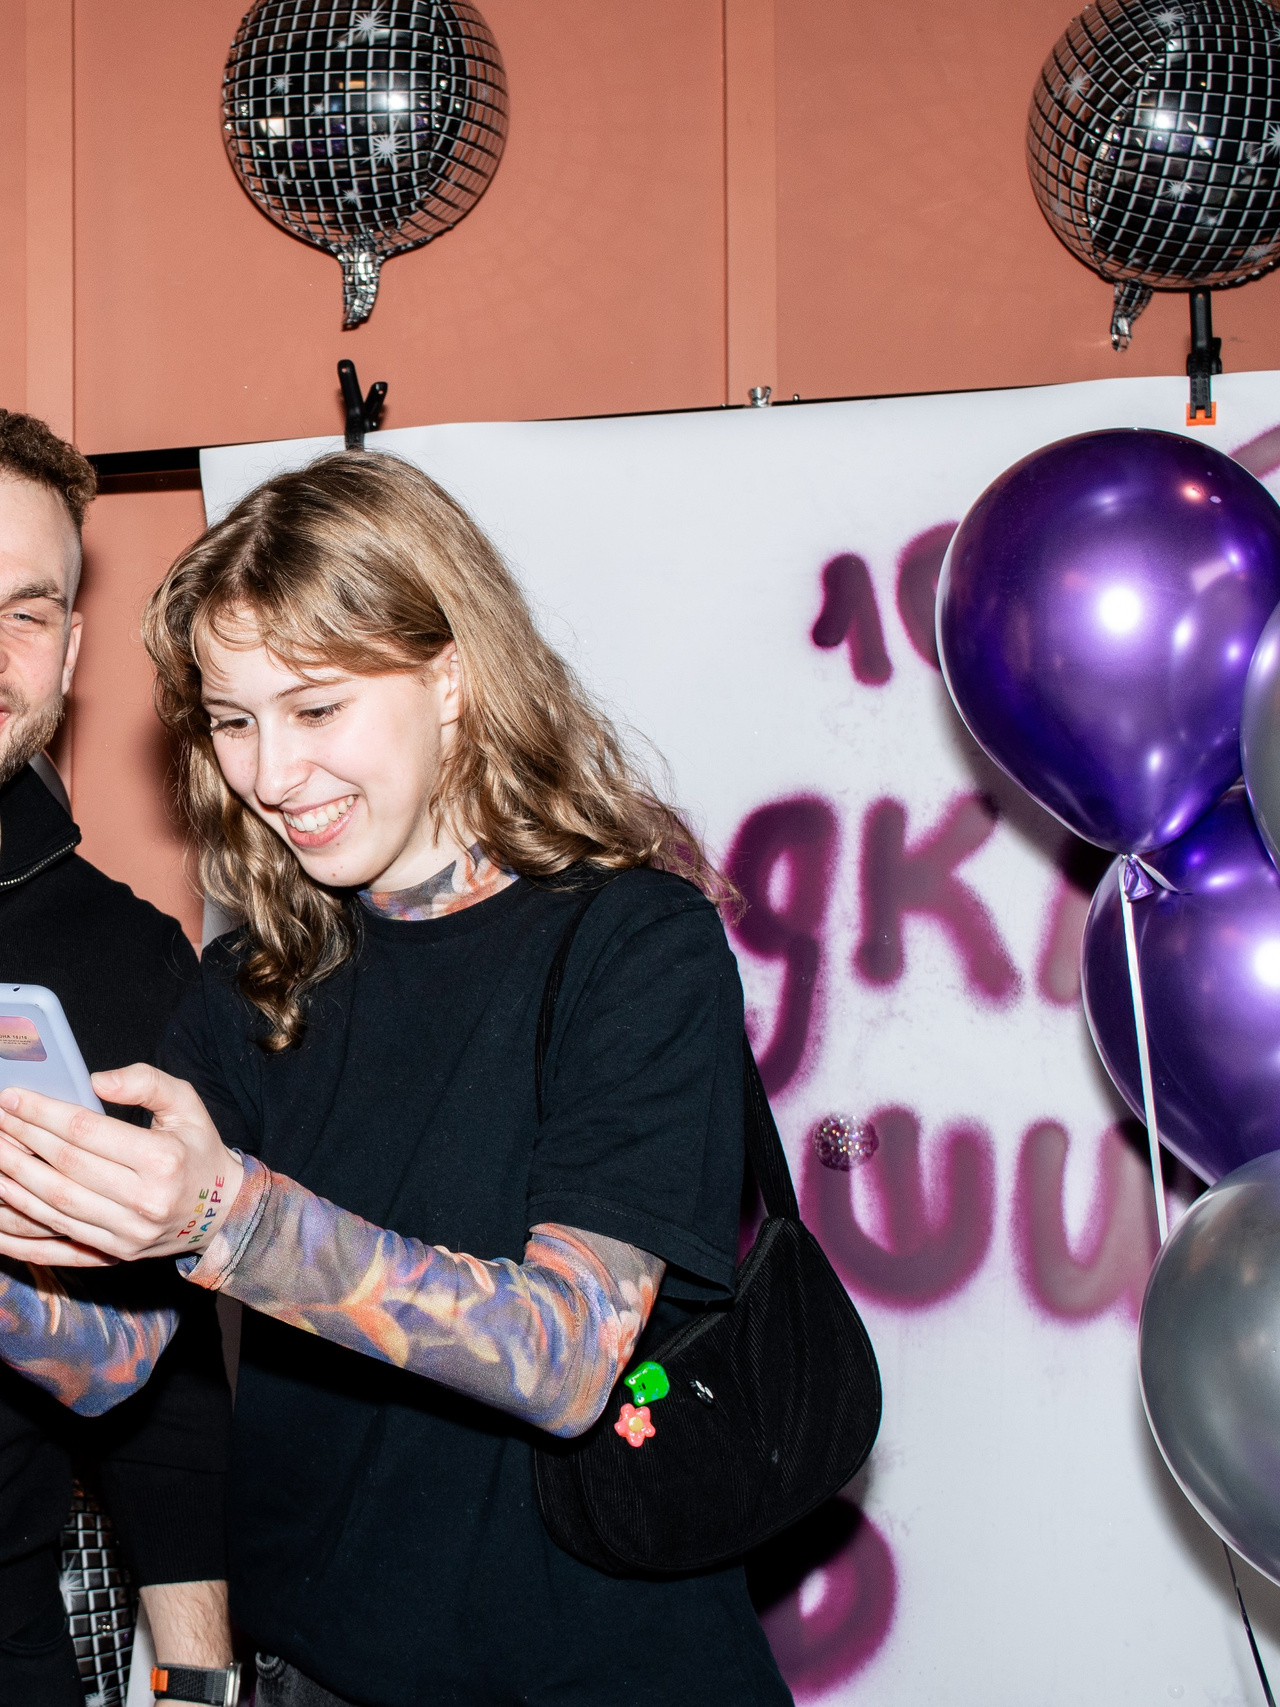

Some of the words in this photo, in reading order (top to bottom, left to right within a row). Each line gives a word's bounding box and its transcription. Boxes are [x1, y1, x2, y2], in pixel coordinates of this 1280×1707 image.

[177, 1220, 197, 1238] TO
[194, 1188, 209, 1213] BE
[188, 1175, 225, 1244] HAPPE
